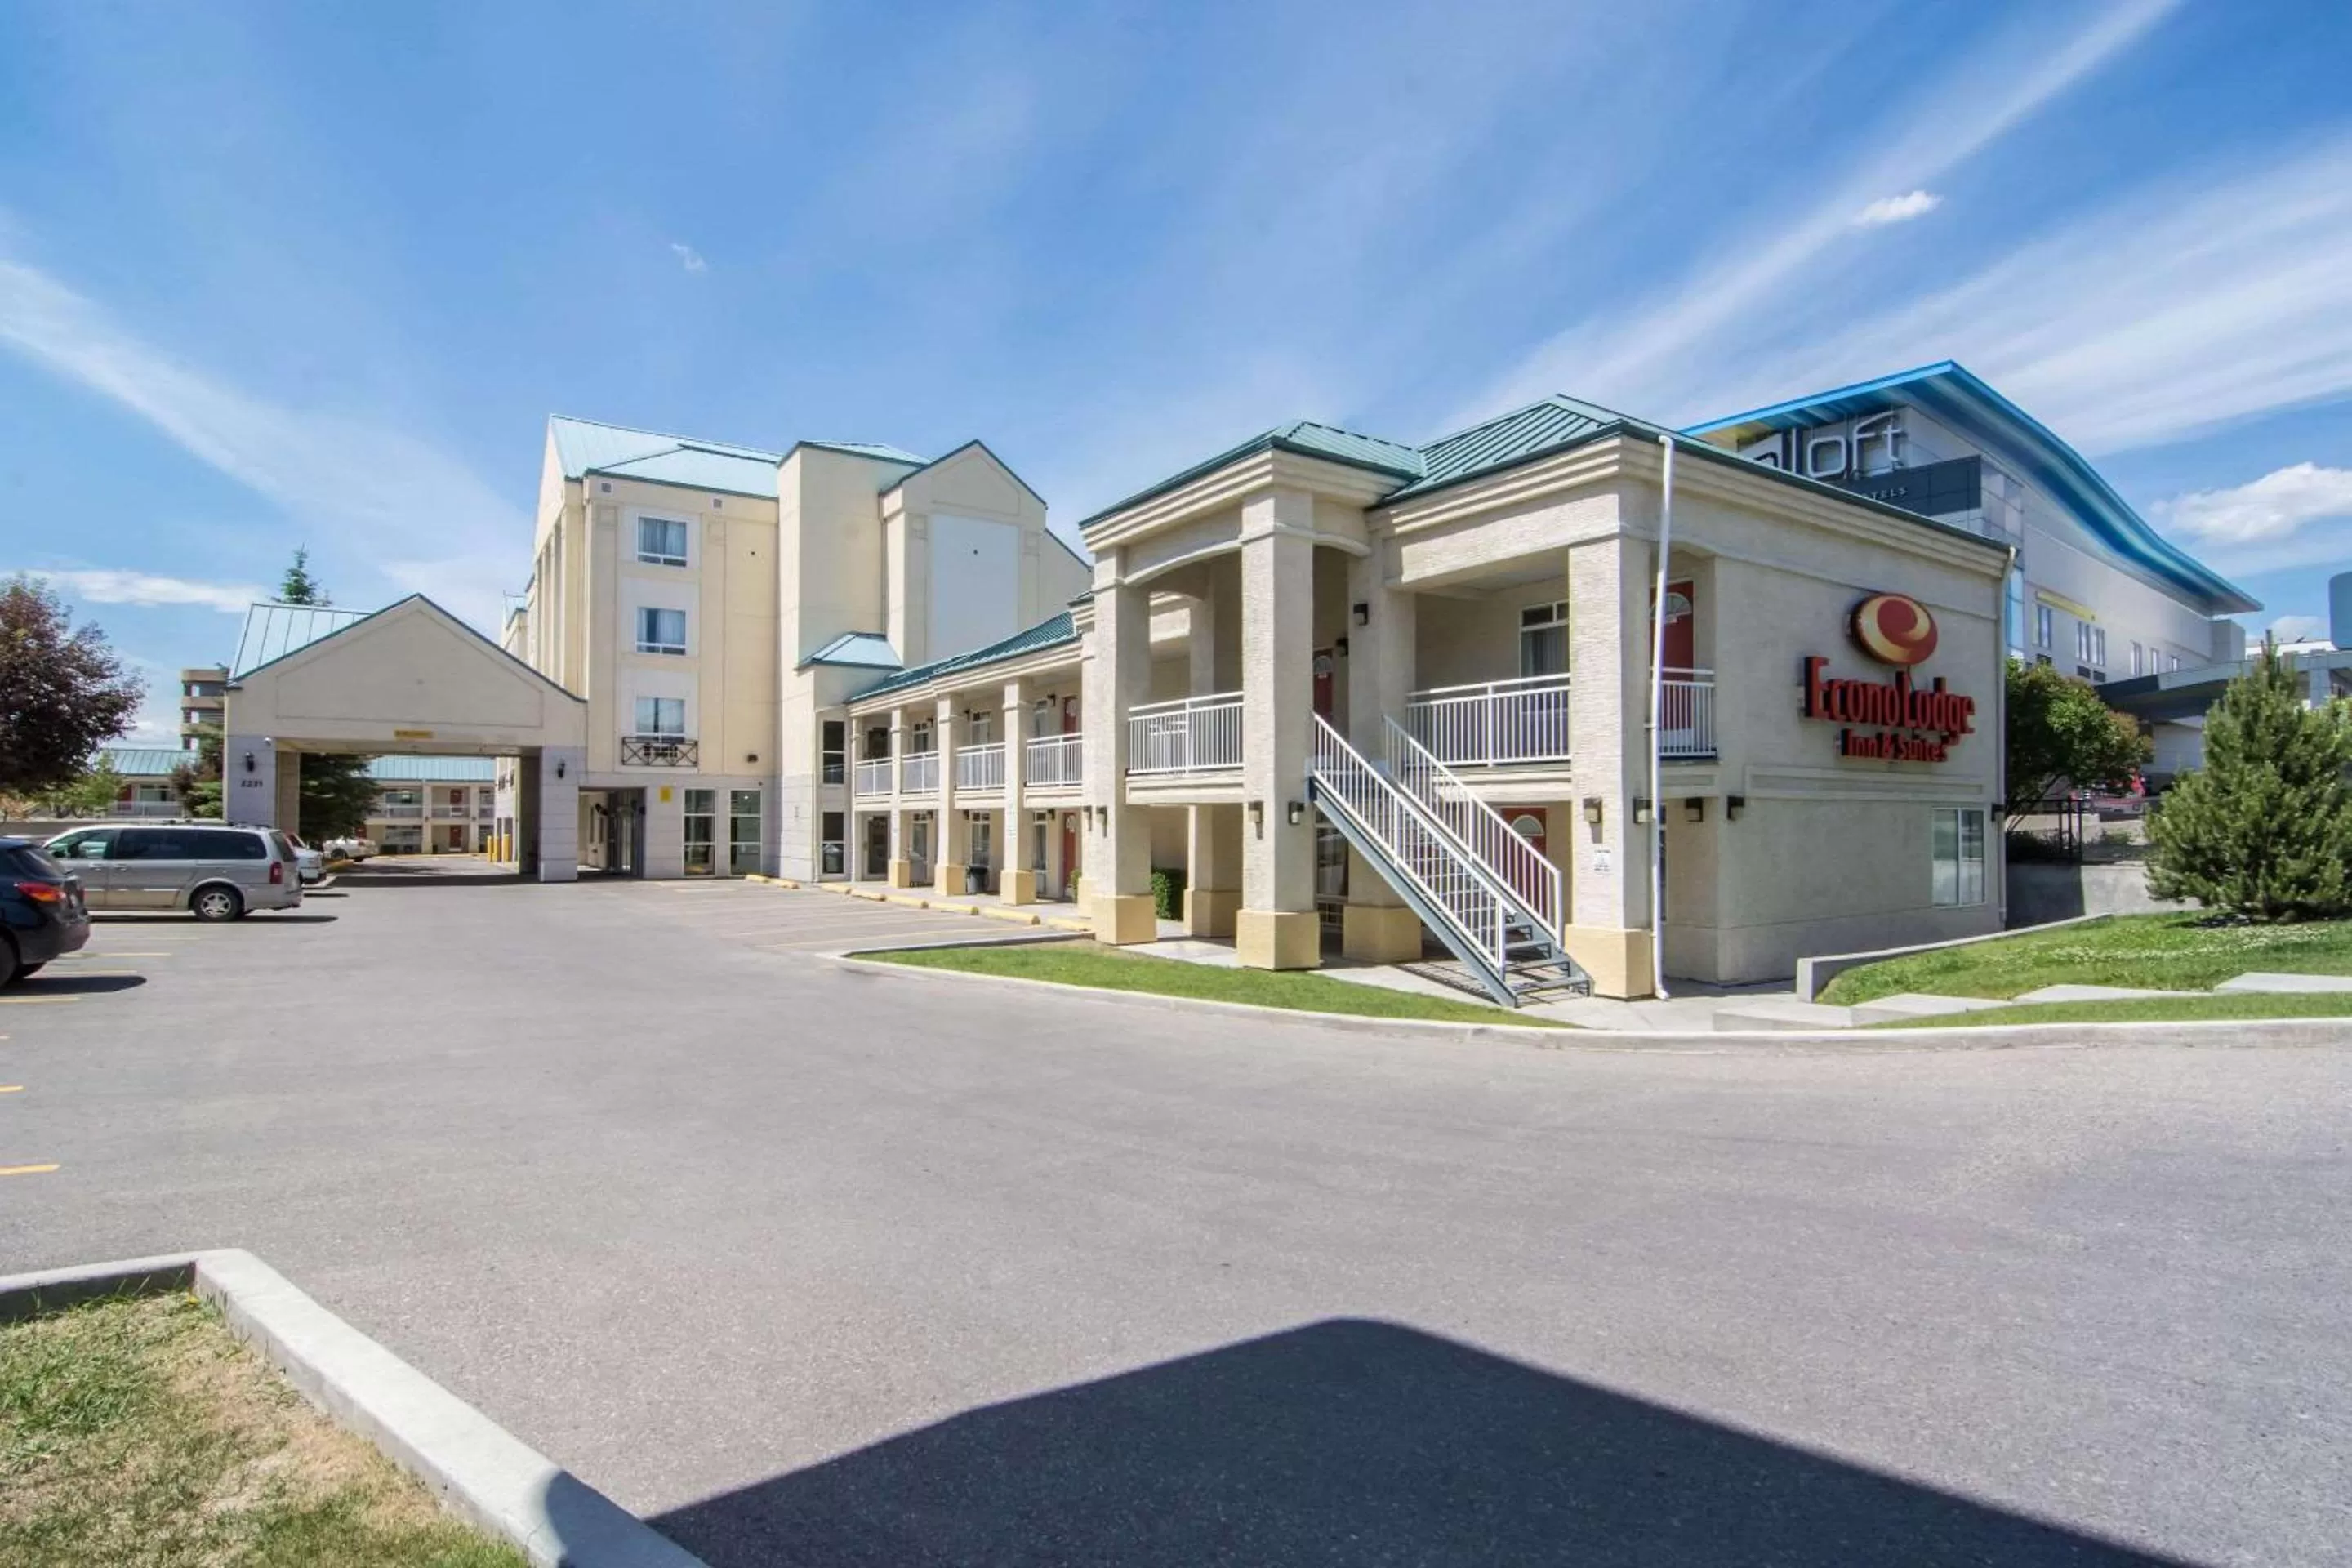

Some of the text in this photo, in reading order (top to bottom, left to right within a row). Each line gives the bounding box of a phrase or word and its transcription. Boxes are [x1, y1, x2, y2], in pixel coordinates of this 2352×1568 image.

[1842, 728, 1948, 763] Inn & Suites
